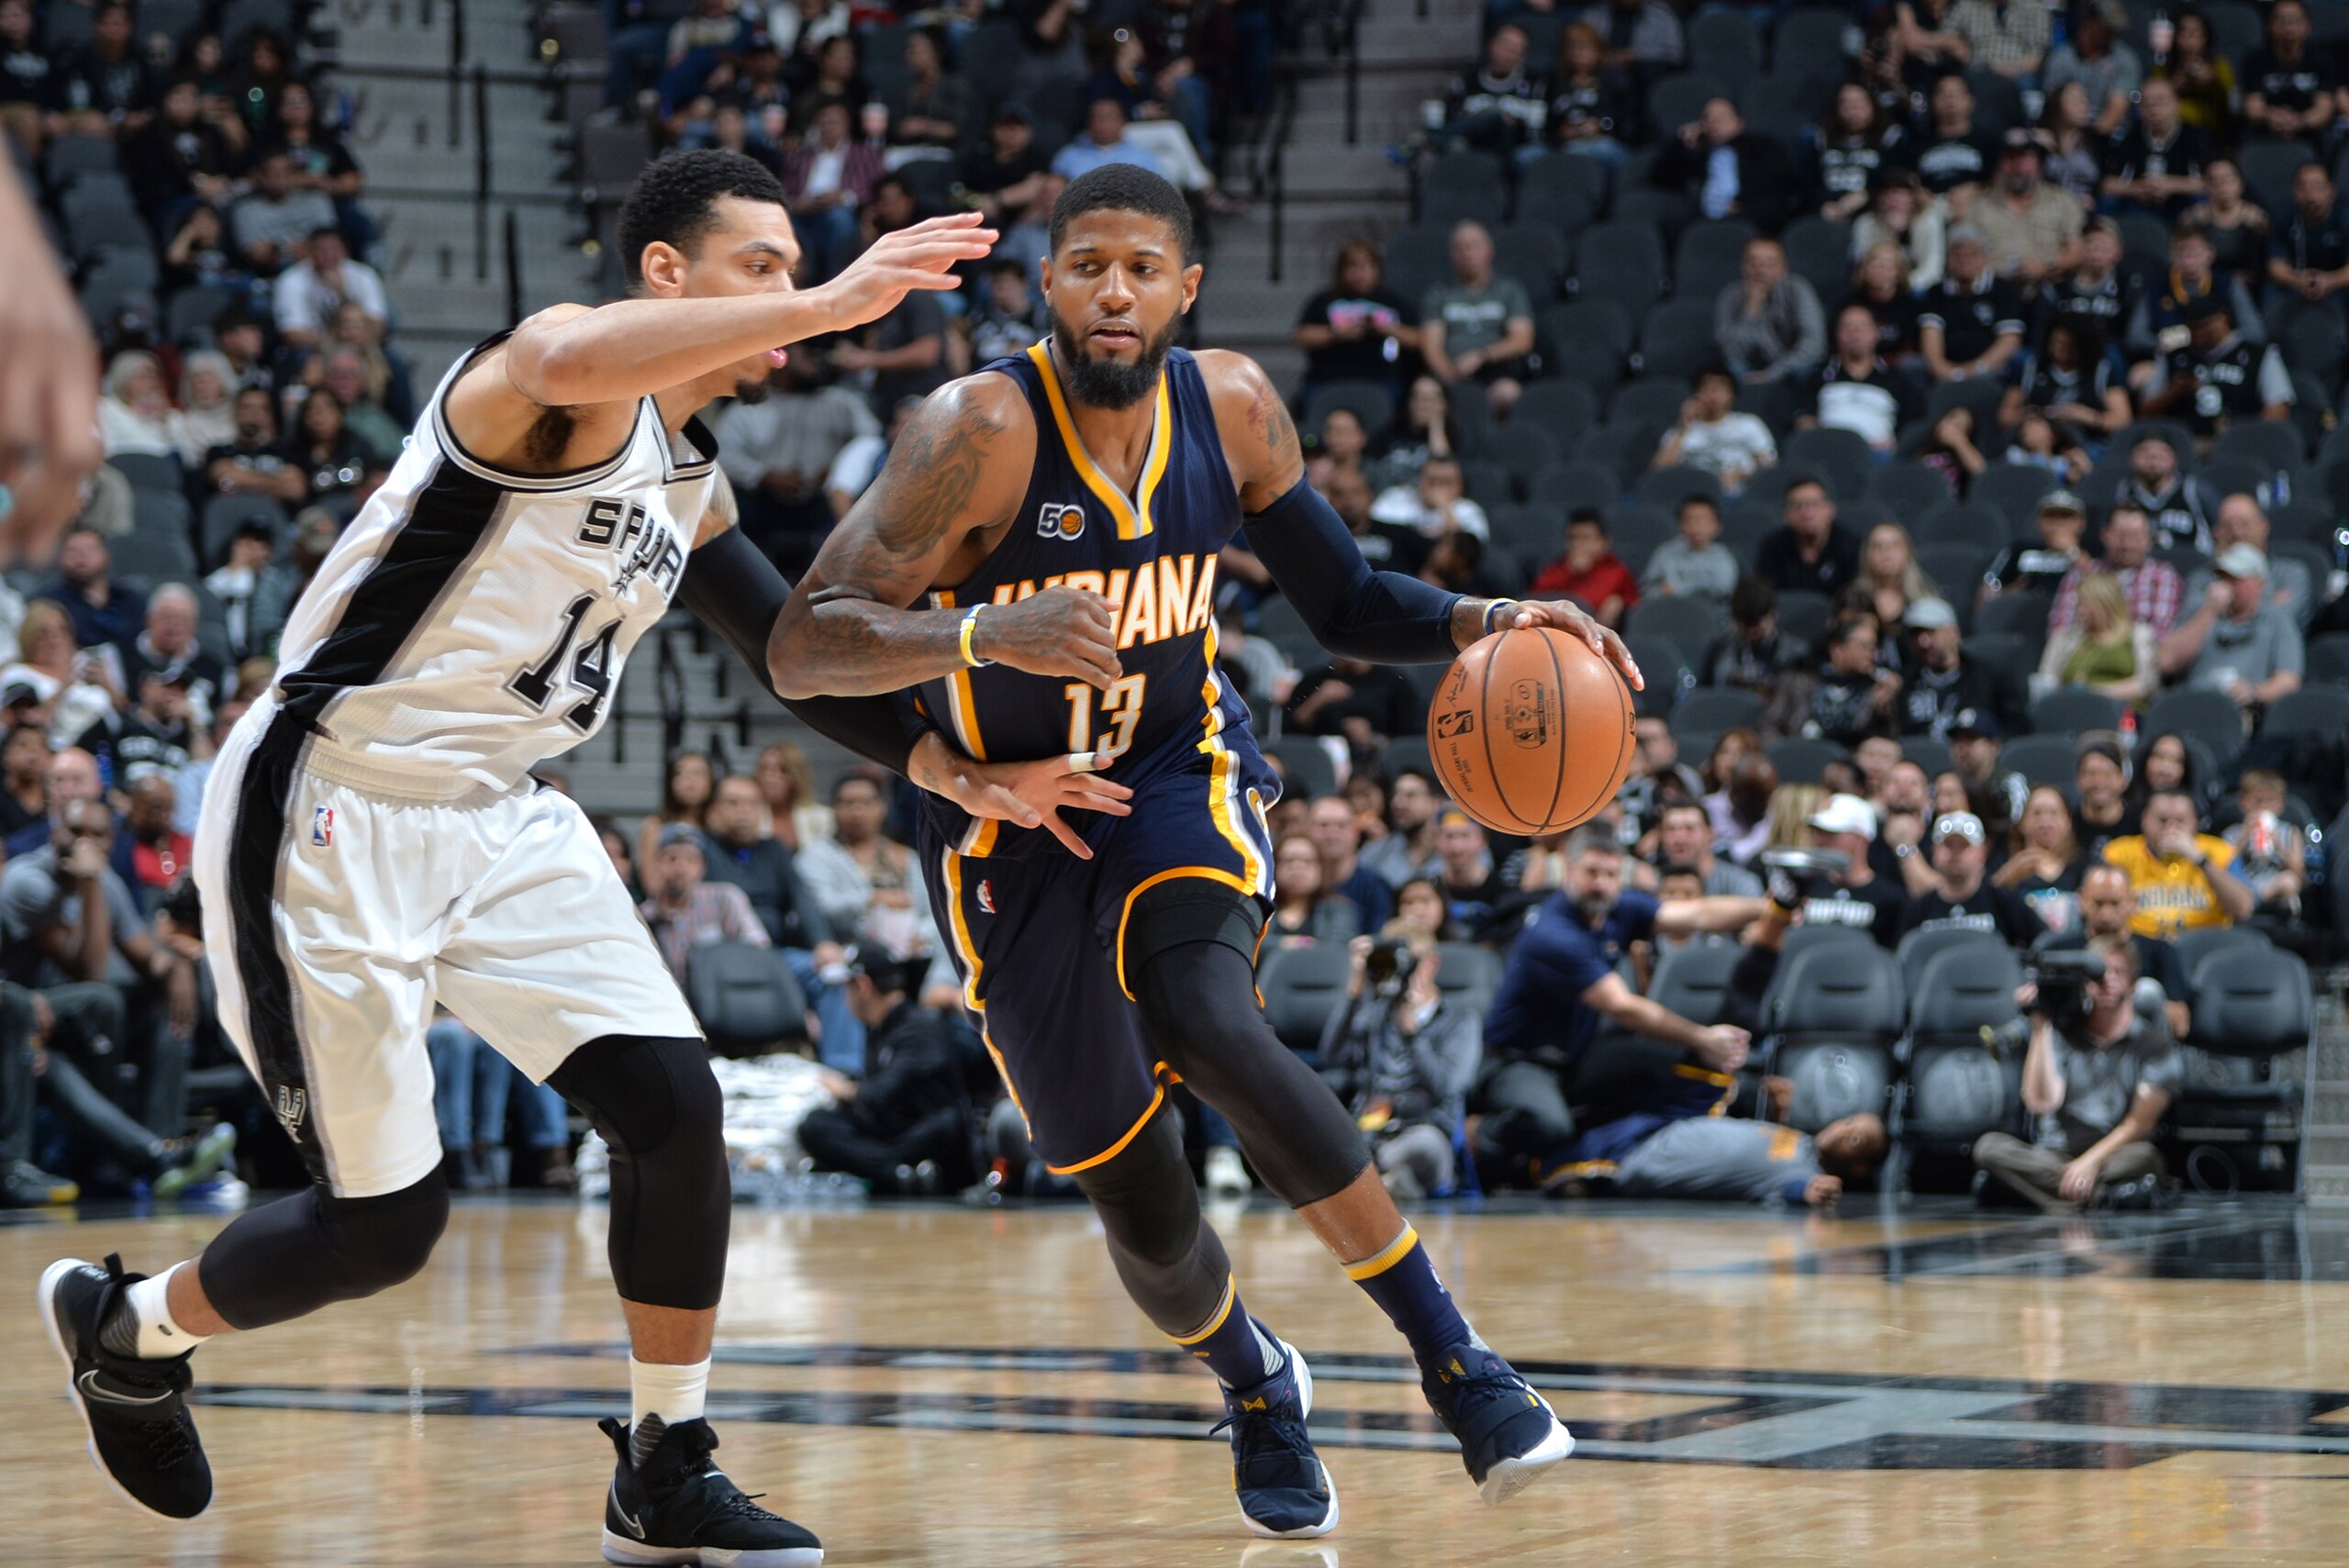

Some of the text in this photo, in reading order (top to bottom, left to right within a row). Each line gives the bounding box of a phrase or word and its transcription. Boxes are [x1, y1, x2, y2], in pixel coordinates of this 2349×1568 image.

[573, 496, 683, 601] SPUR
[1037, 503, 1085, 541] 50
[993, 553, 1219, 650] IANA
[503, 588, 627, 737] 14
[1064, 673, 1147, 760] 13
[2135, 884, 2207, 911] NDIANA
